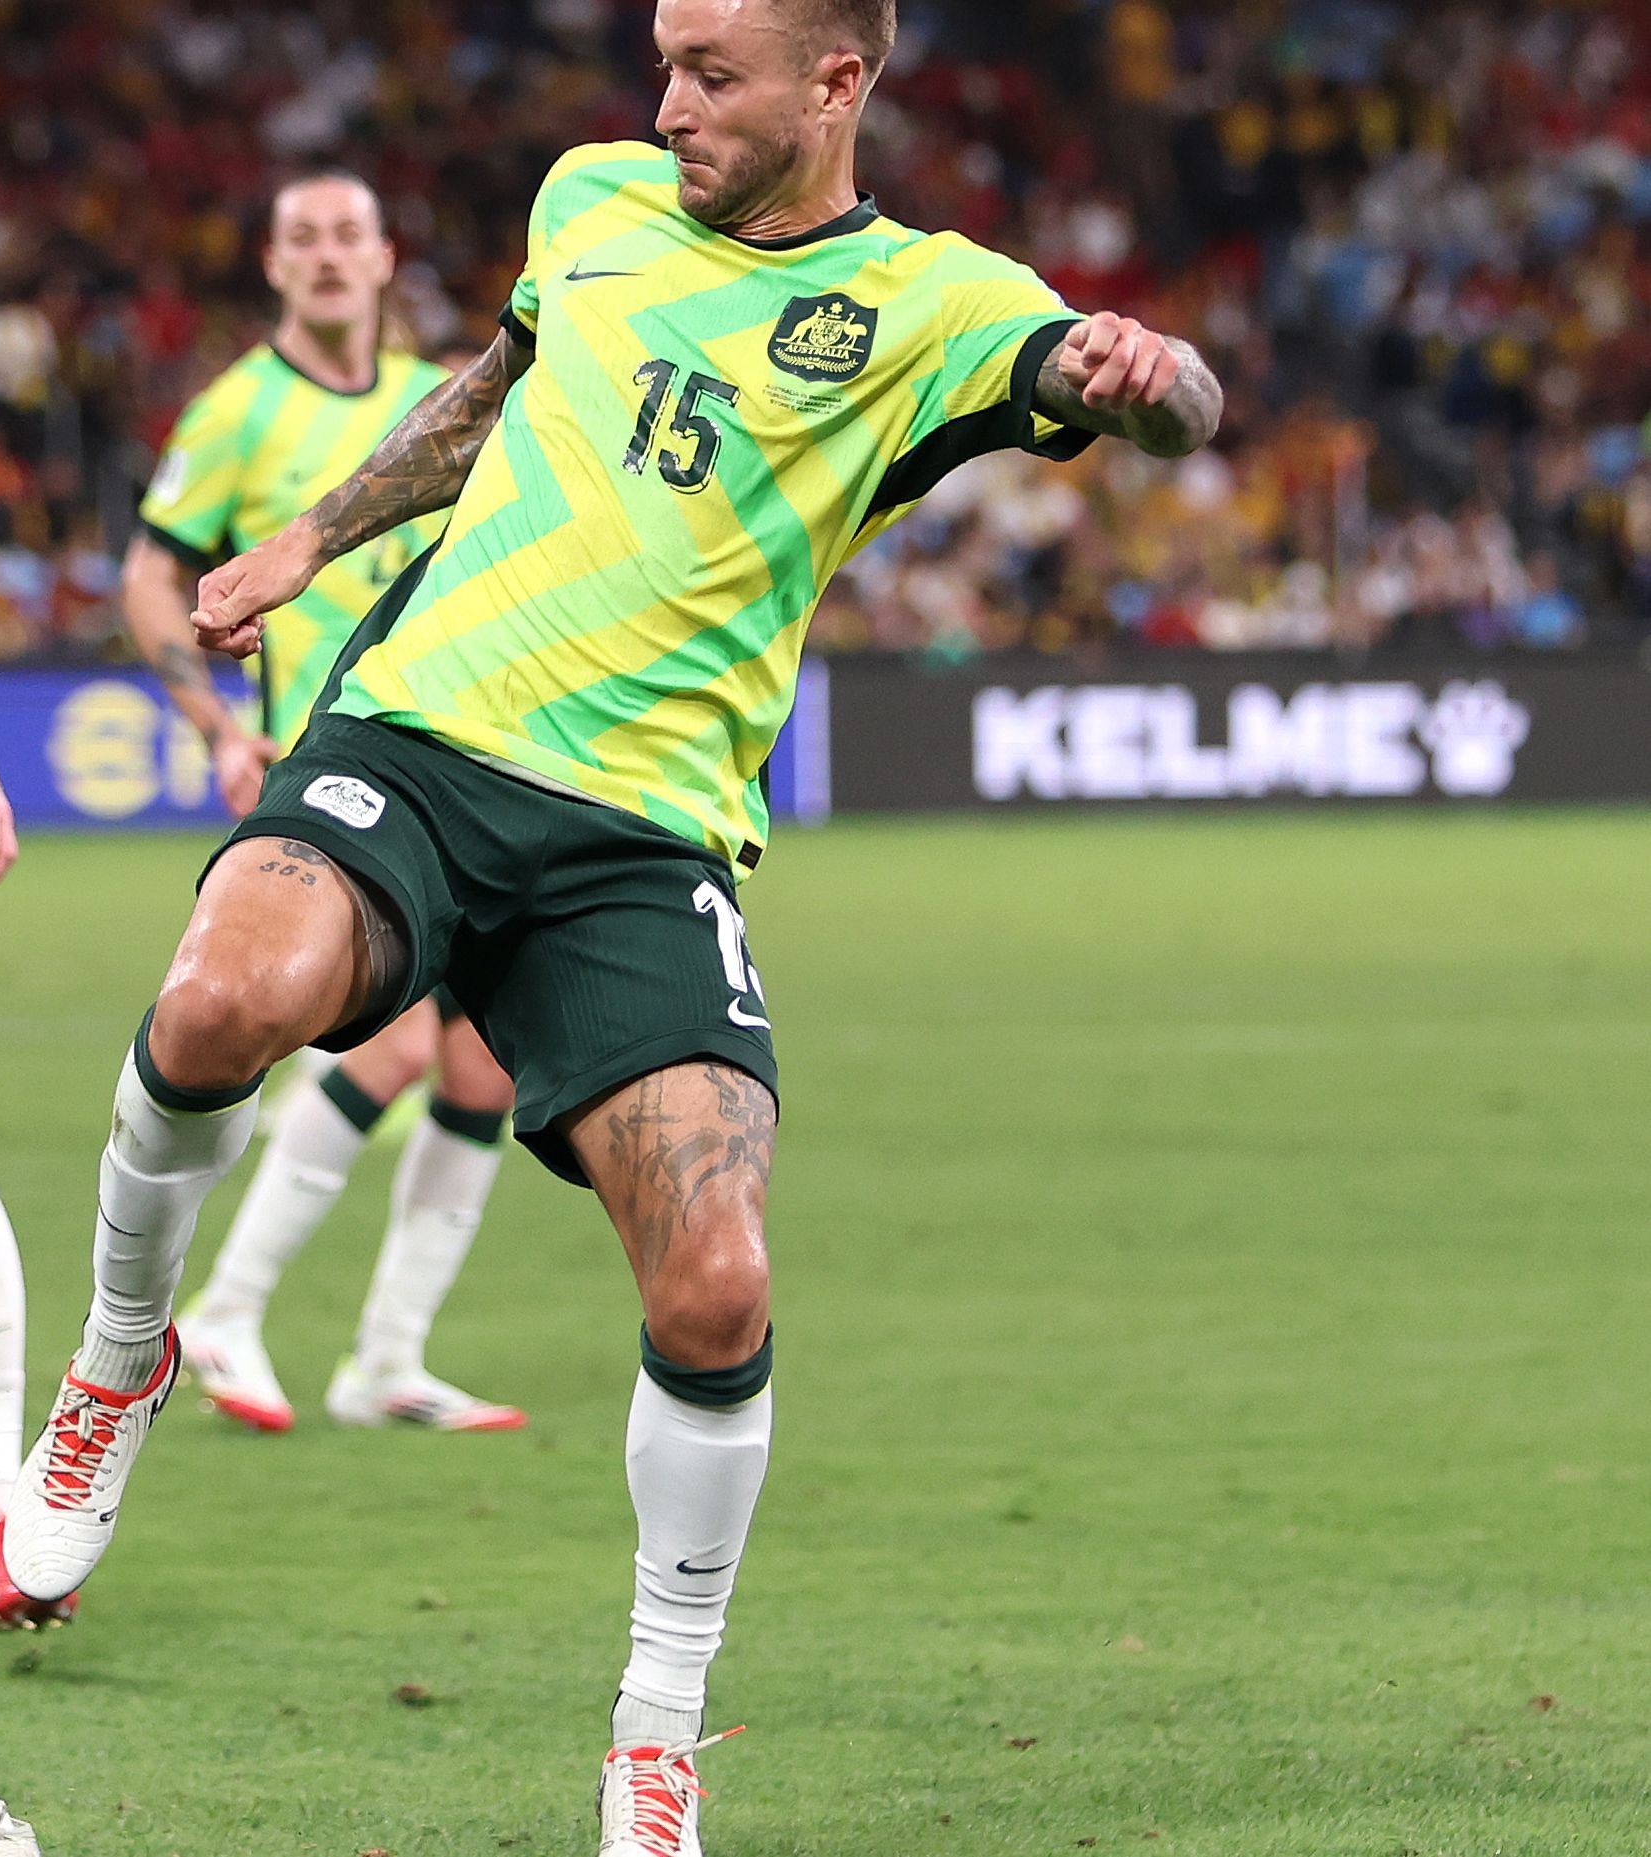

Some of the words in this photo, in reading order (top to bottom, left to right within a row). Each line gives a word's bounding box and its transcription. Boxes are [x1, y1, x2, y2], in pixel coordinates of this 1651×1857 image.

[785, 344, 849, 360] AUSTRALIA
[622, 358, 741, 495] 15
[971, 681, 1427, 799] KELME
